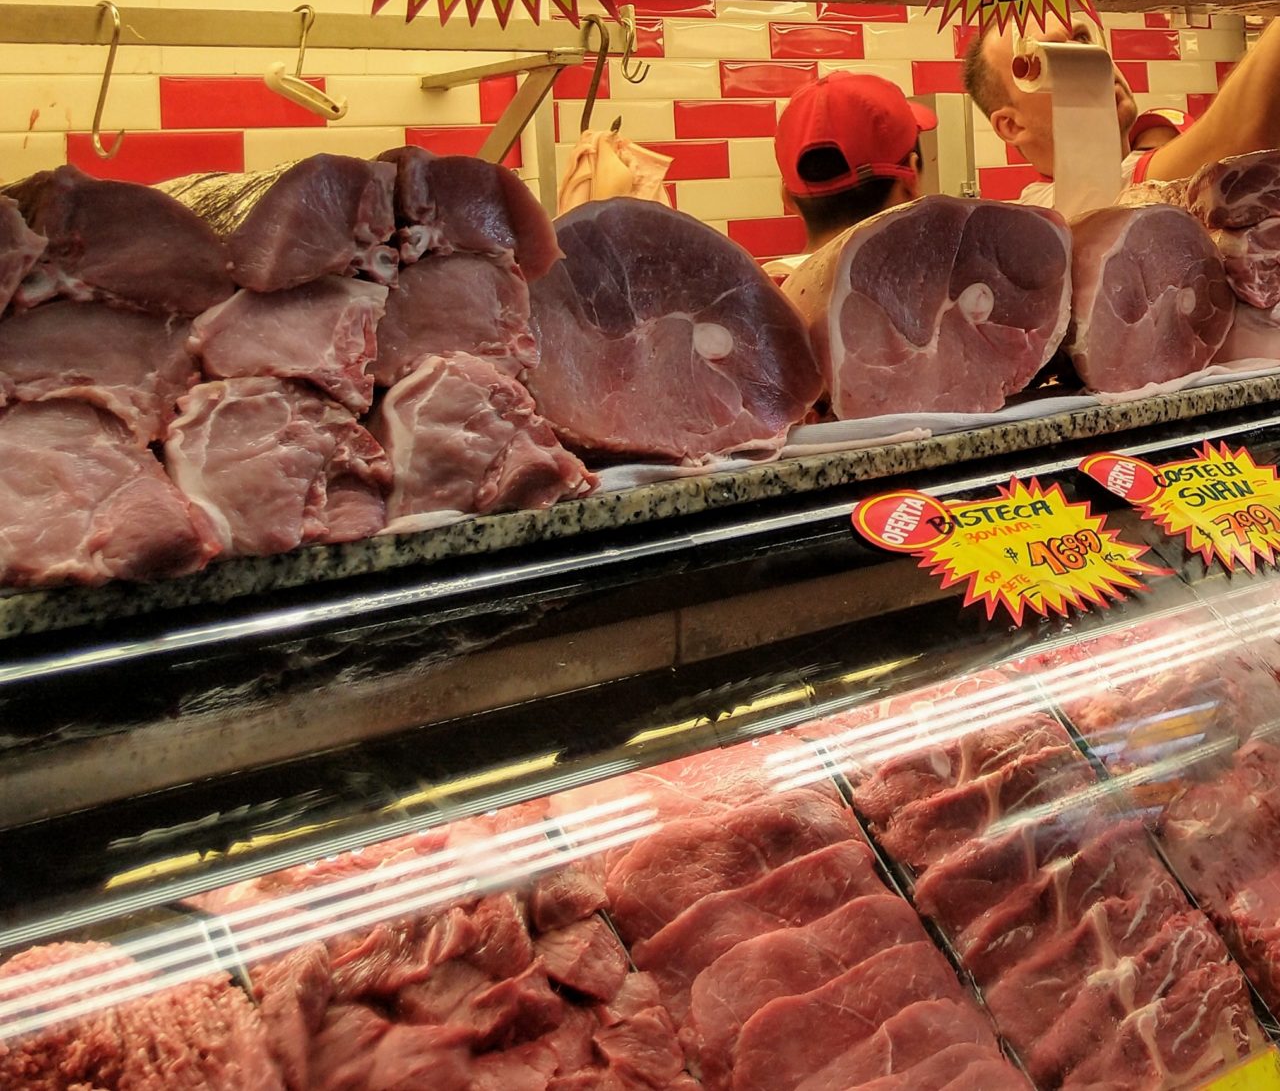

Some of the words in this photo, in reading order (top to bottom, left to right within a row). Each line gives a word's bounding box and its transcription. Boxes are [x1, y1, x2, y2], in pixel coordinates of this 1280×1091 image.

[1106, 461, 1137, 498] OFERTA
[1153, 461, 1244, 488] COSTELA
[881, 497, 926, 545] OFERTA
[926, 499, 1054, 536] BISTECA
